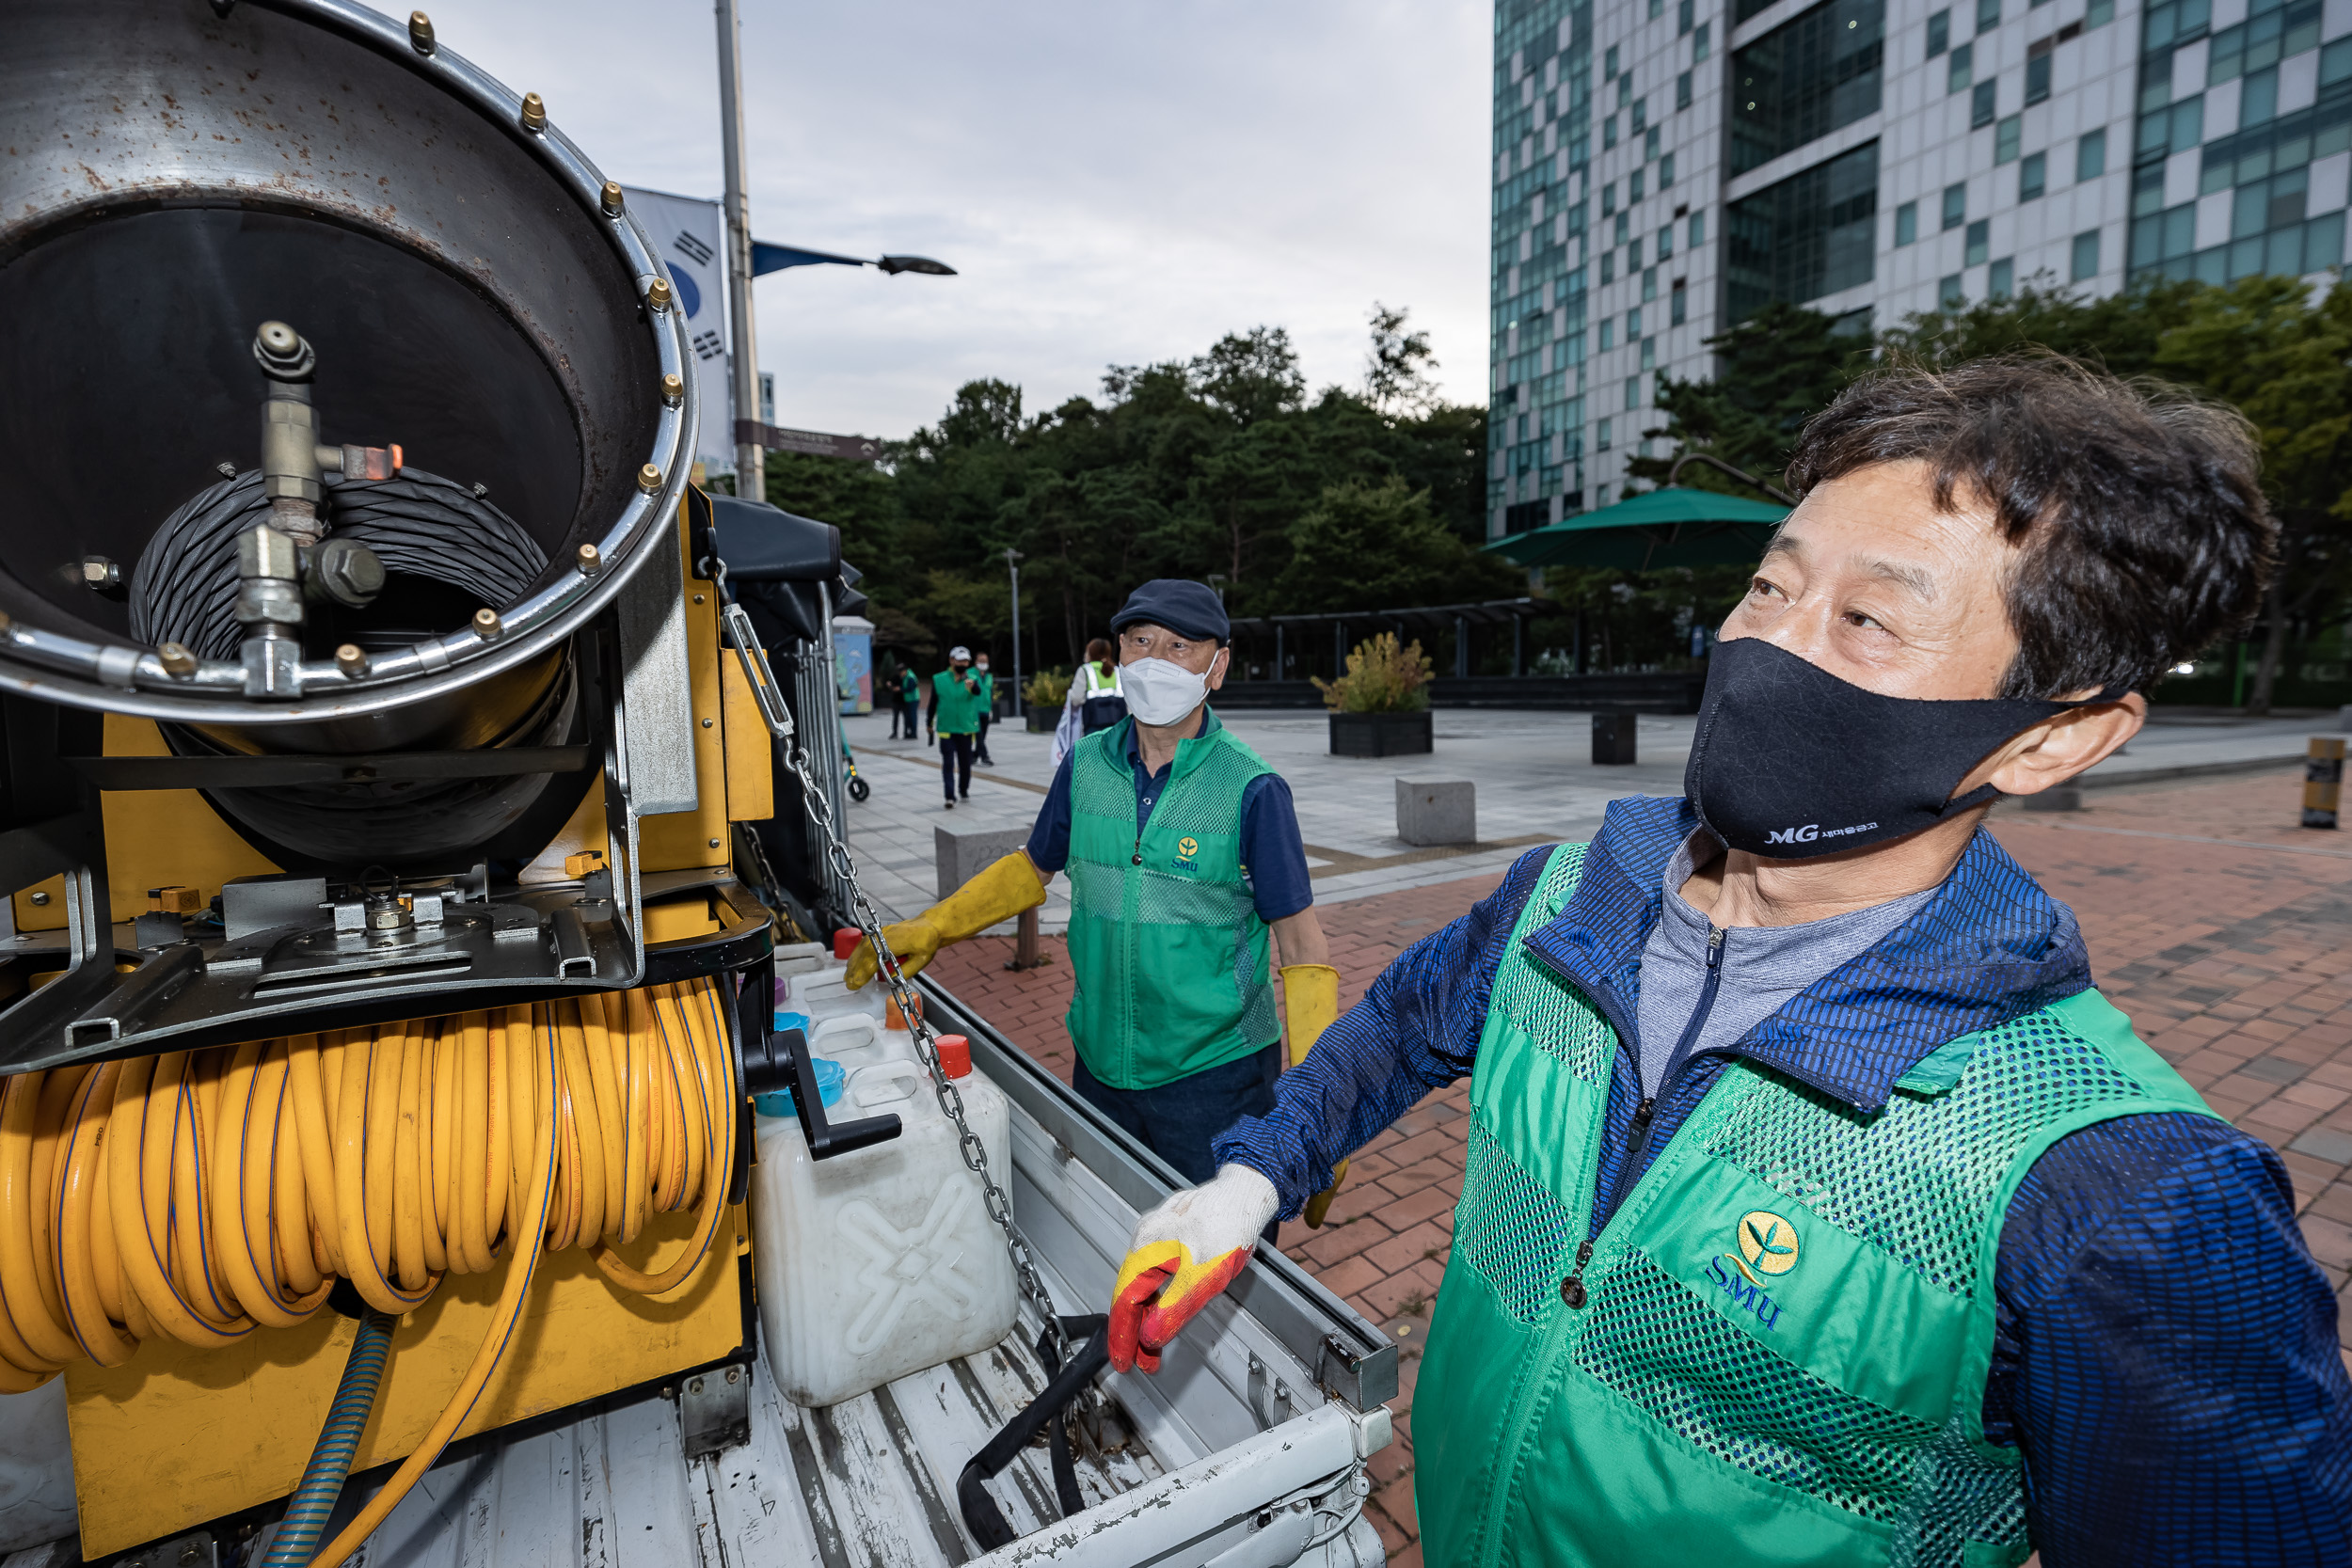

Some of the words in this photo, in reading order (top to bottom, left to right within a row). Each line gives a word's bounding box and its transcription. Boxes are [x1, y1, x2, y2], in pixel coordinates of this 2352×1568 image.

[1764, 824, 1820, 845] MG
[1821, 822, 1879, 838] 새마을금고
[1170, 858, 1199, 872] SMU
[1705, 1255, 1784, 1332] SMU
